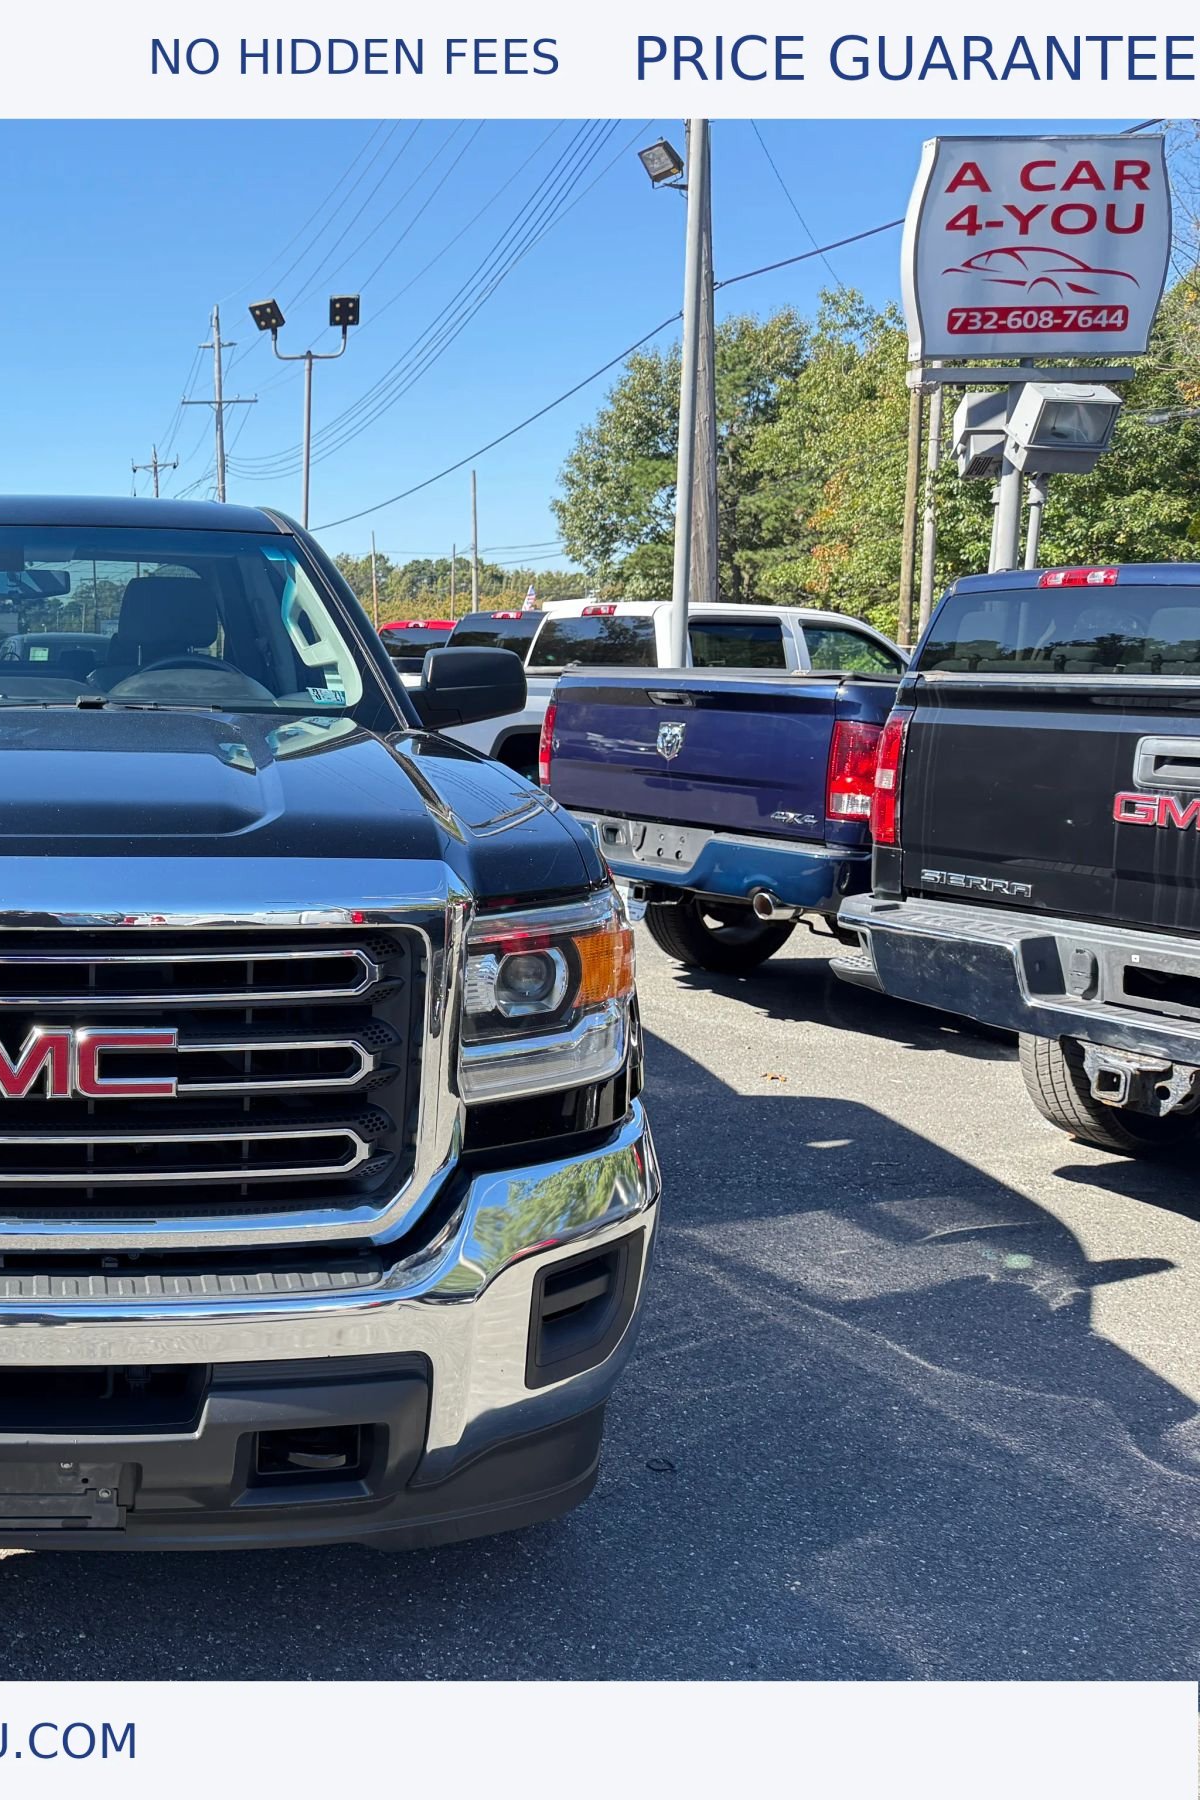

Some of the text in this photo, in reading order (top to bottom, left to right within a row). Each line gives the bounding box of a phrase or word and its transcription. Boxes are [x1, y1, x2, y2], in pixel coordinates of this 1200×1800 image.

[945, 160, 1151, 193] A CAR
[945, 203, 1145, 236] 4-YOU
[951, 309, 1124, 331] 732-608-7644
[1113, 791, 1200, 831] GM
[920, 868, 1032, 898] SIERRA
